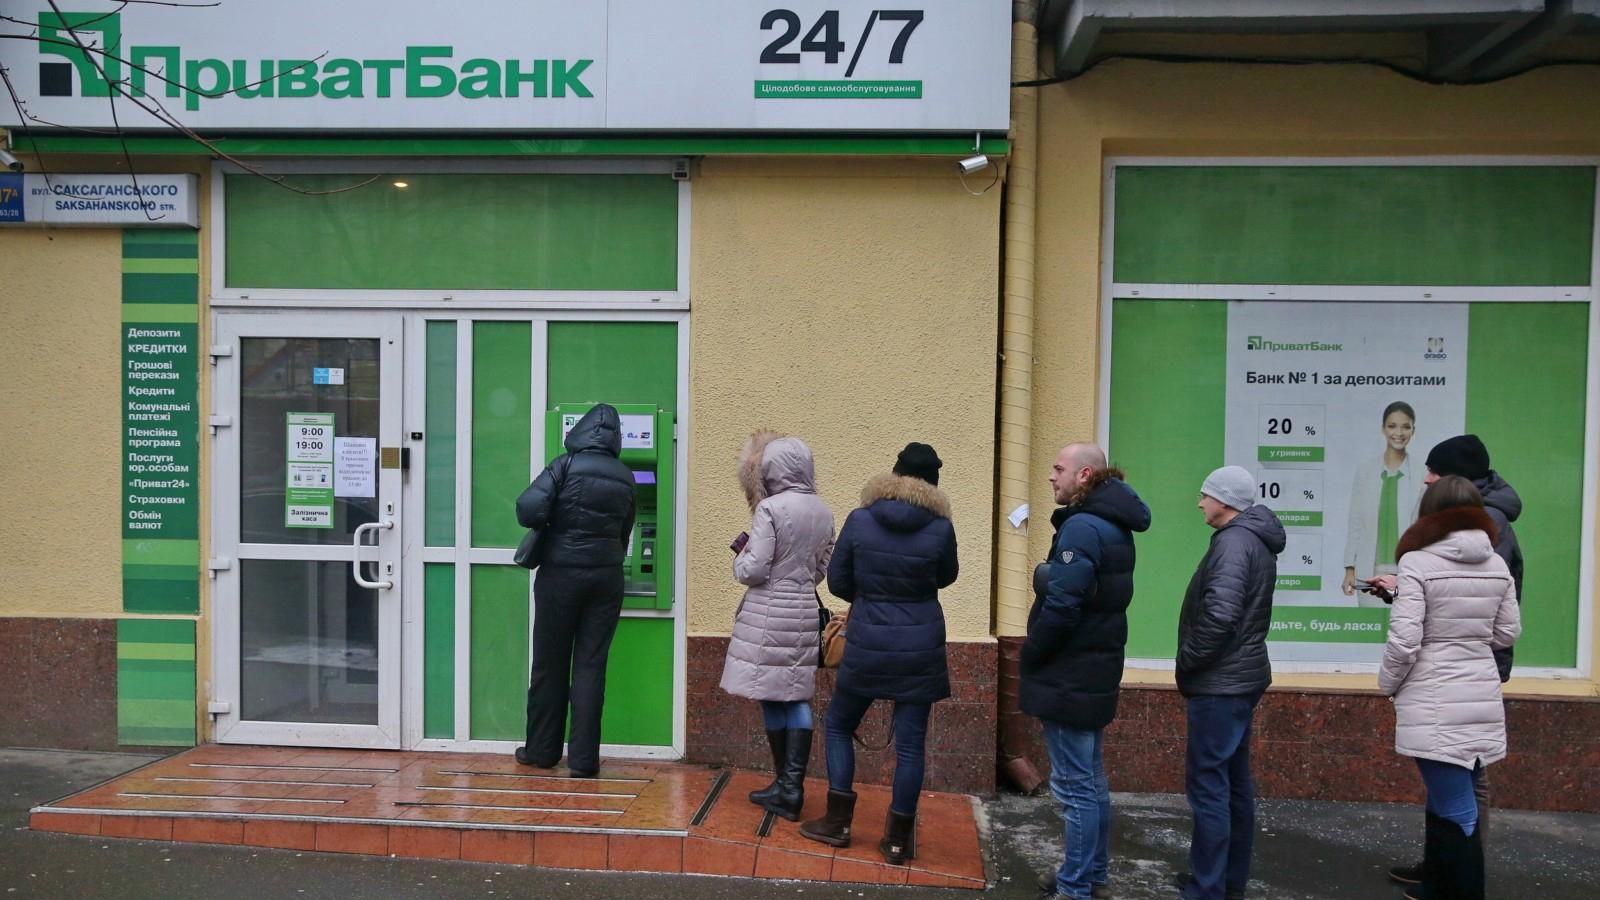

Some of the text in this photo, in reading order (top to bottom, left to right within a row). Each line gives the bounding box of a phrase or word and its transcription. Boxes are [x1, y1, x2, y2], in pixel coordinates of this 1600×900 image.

[759, 9, 924, 78] 24/7
[130, 46, 594, 111] ПриватБанк
[761, 84, 916, 94] Цілодобове самообслуговування
[54, 184, 178, 196] САКСАГАНСЬКОГО
[55, 200, 156, 211] SAKSAHANSKOHO
[128, 328, 181, 339] Депозити
[128, 344, 188, 355] КРЕДИТКИ
[1262, 341, 1343, 352] ПриватБанк
[128, 360, 173, 371] Грошові
[128, 371, 180, 381] перекази
[1246, 371, 1446, 387] Банк № 1 за депозитами
[128, 386, 175, 397] Кредити
[128, 402, 190, 413] Комунальні
[128, 412, 171, 421] платежі
[128, 427, 178, 437] Пенсійна
[301, 427, 324, 436] 9:00
[1267, 418, 1316, 436] 20 %
[128, 439, 181, 449] програма
[296, 441, 324, 450] 19:00
[128, 453, 174, 463] Послуги
[128, 463, 189, 473] юр.особам
[128, 479, 190, 489] «Приват24»
[1259, 482, 1314, 500] 10 %
[128, 495, 185, 505] Страховки
[128, 510, 161, 520] Обмін
[128, 521, 162, 530] валют
[1302, 555, 1312, 565] %
[1269, 619, 1382, 632] дьте, будь ласка
